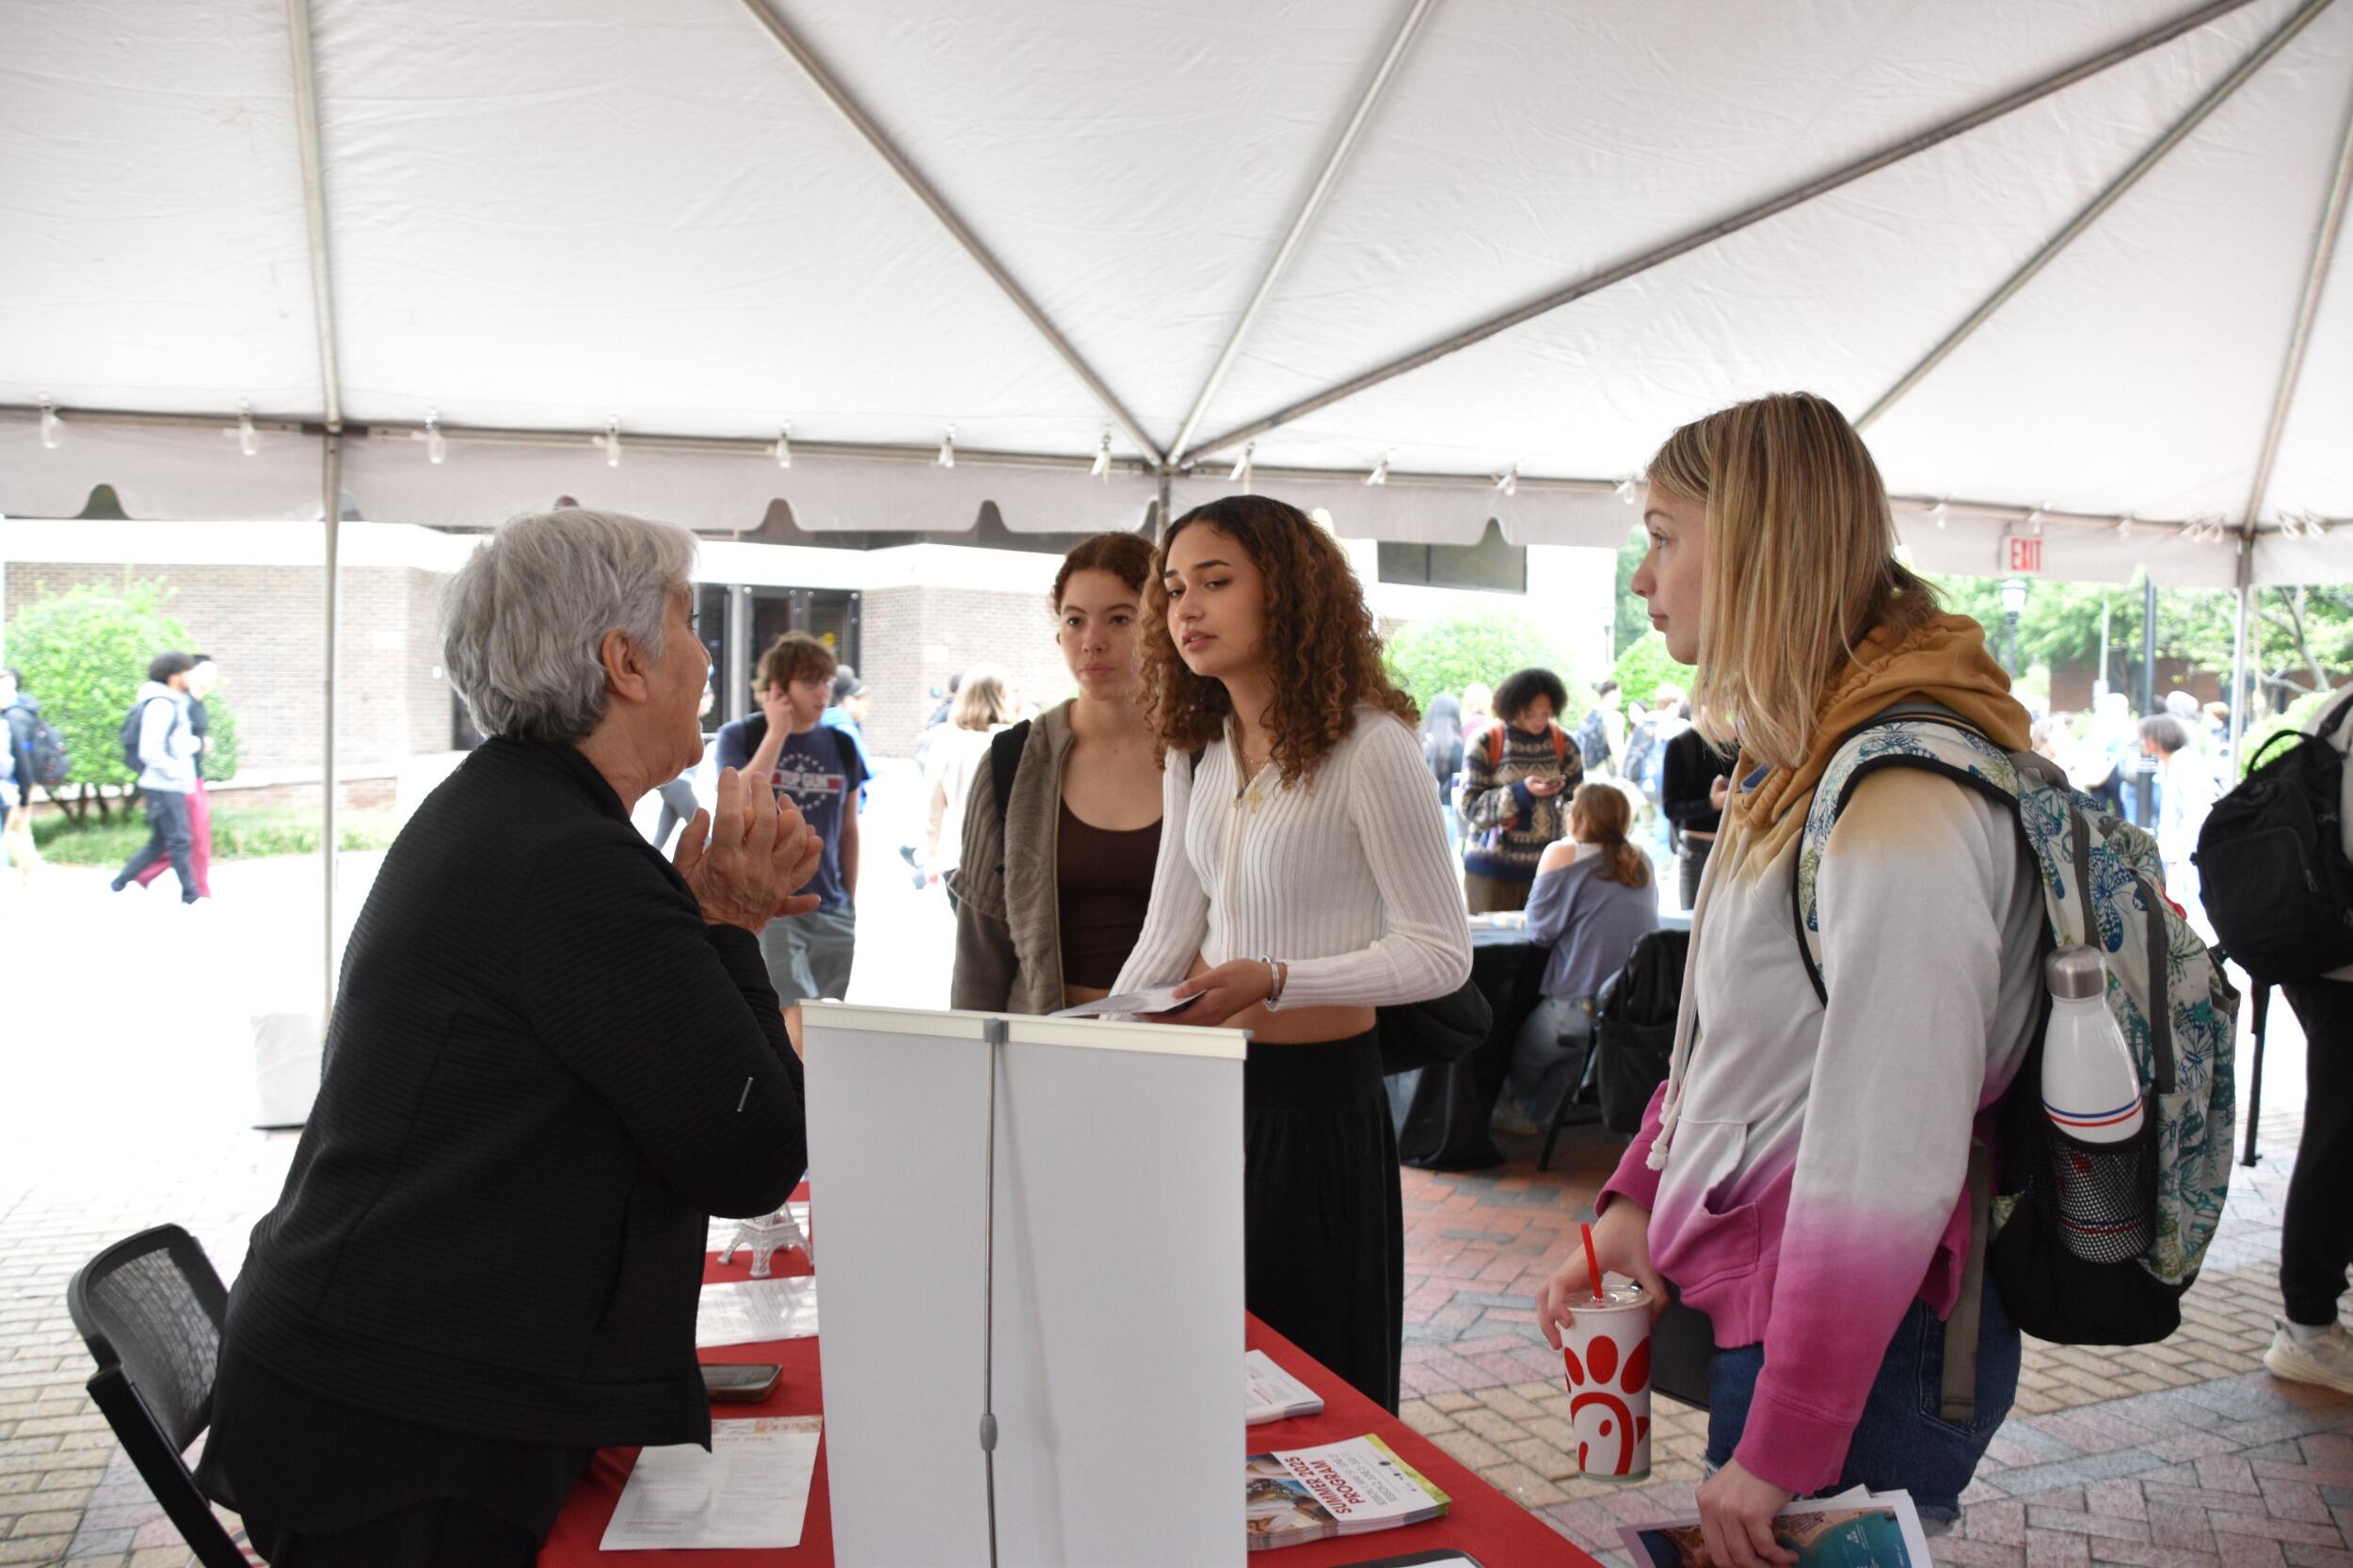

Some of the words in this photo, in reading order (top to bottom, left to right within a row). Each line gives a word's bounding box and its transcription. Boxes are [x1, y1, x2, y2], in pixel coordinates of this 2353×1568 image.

[2011, 538, 2042, 570] EXIT
[781, 769, 801, 787] TOP
[801, 771, 829, 789] GUN
[1285, 1456, 1315, 1477] 2025
[1306, 1480, 1352, 1513] SUMMER
